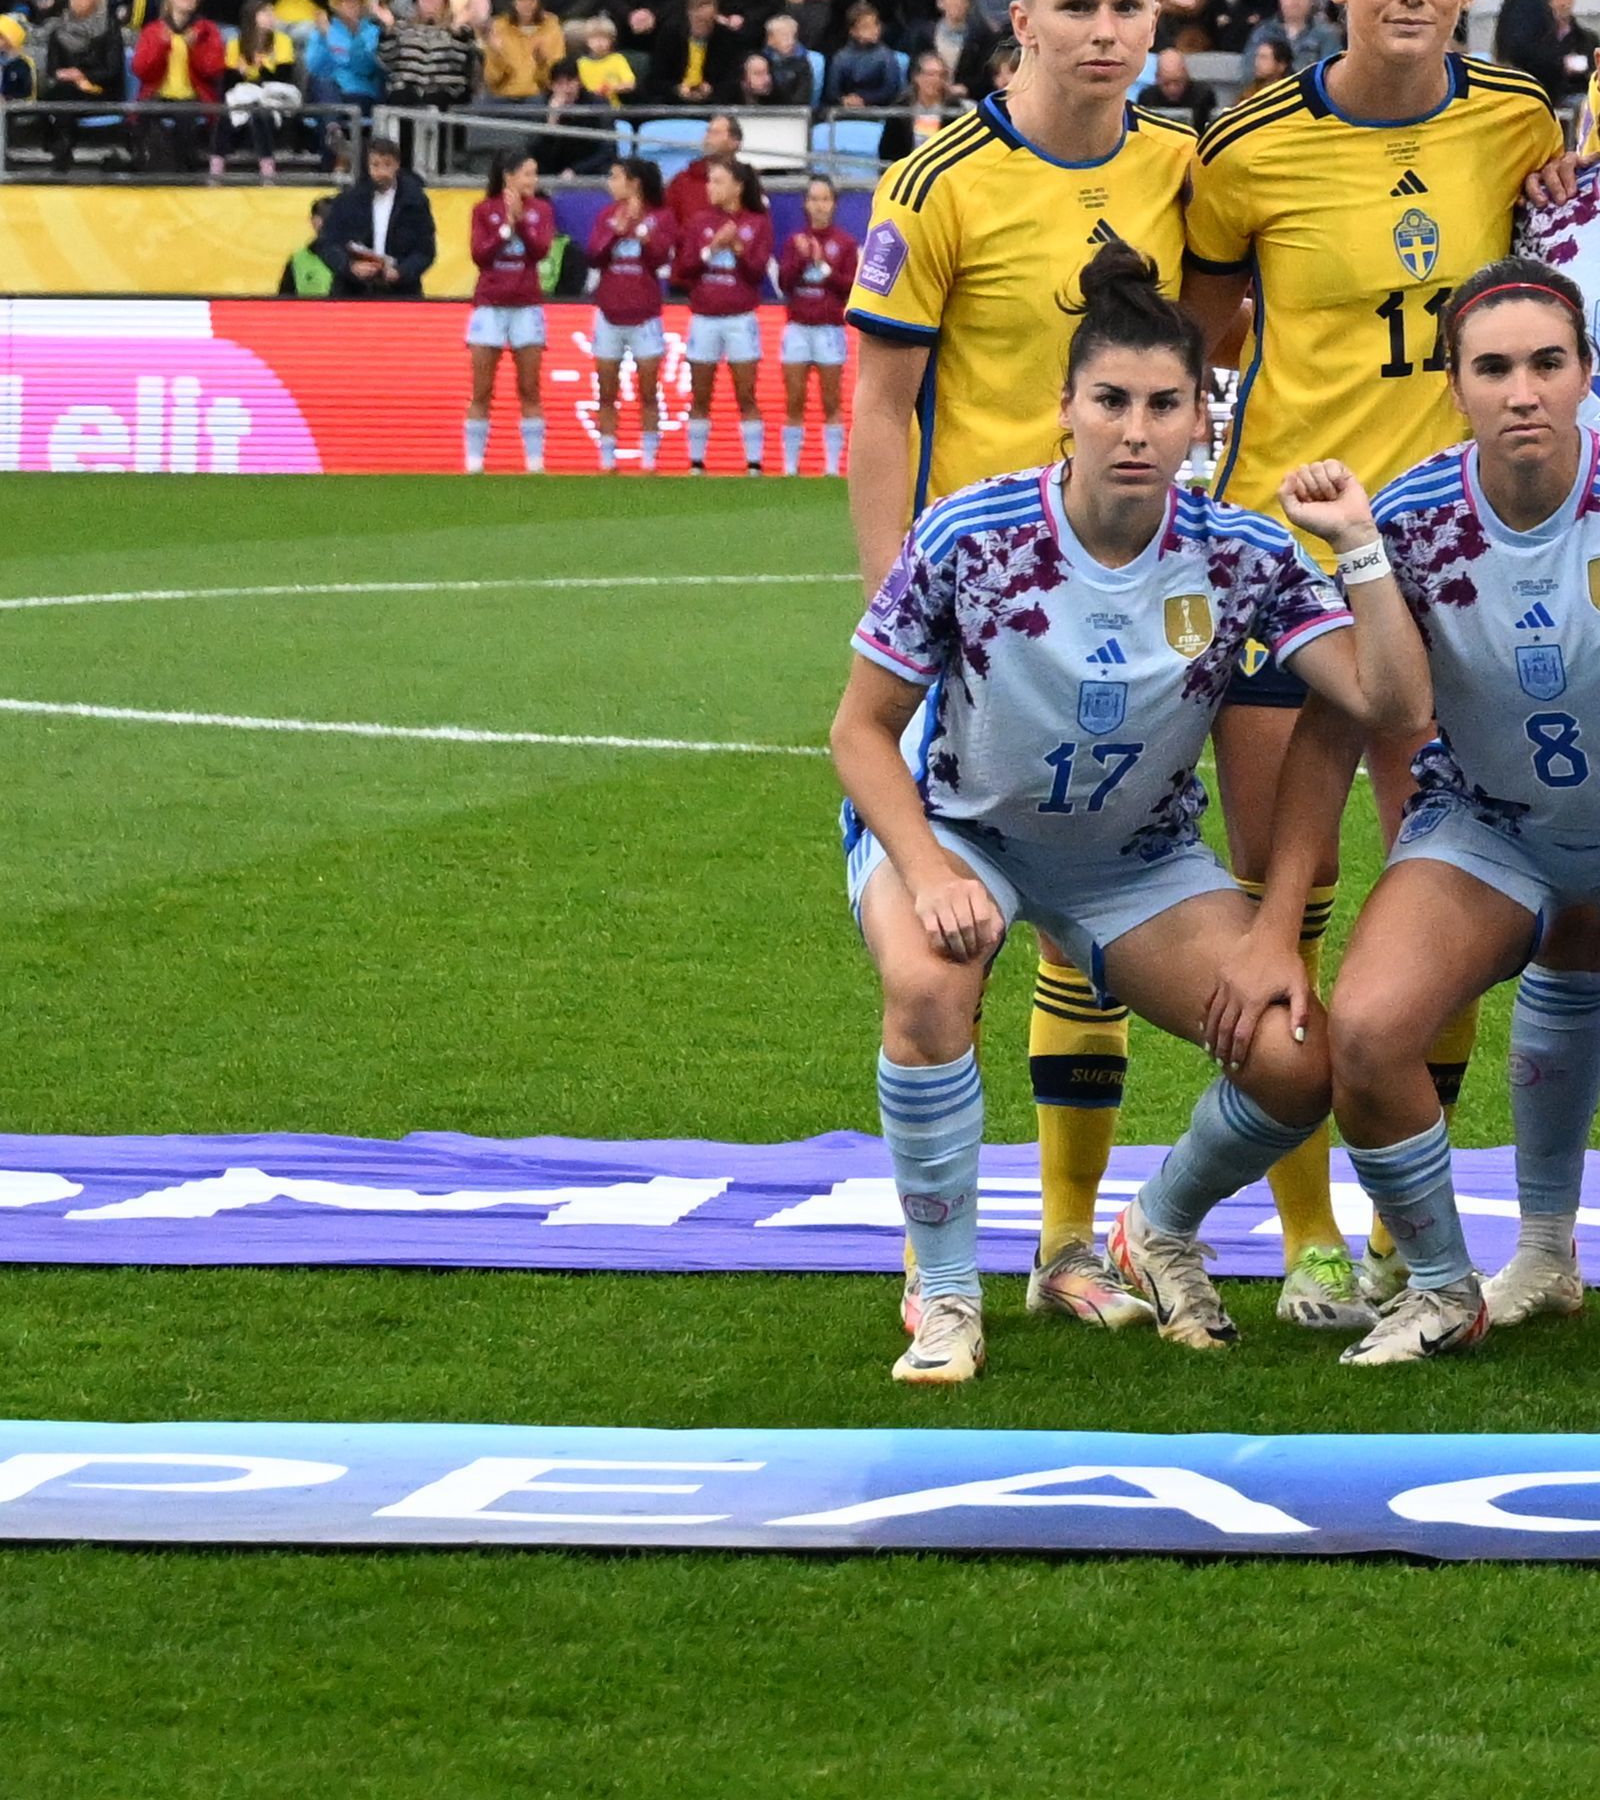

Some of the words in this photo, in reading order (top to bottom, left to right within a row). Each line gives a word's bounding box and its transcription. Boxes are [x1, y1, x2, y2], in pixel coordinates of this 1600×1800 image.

[46, 374, 253, 475] elit
[1037, 741, 1145, 814] 17
[1523, 711, 1591, 788] 8
